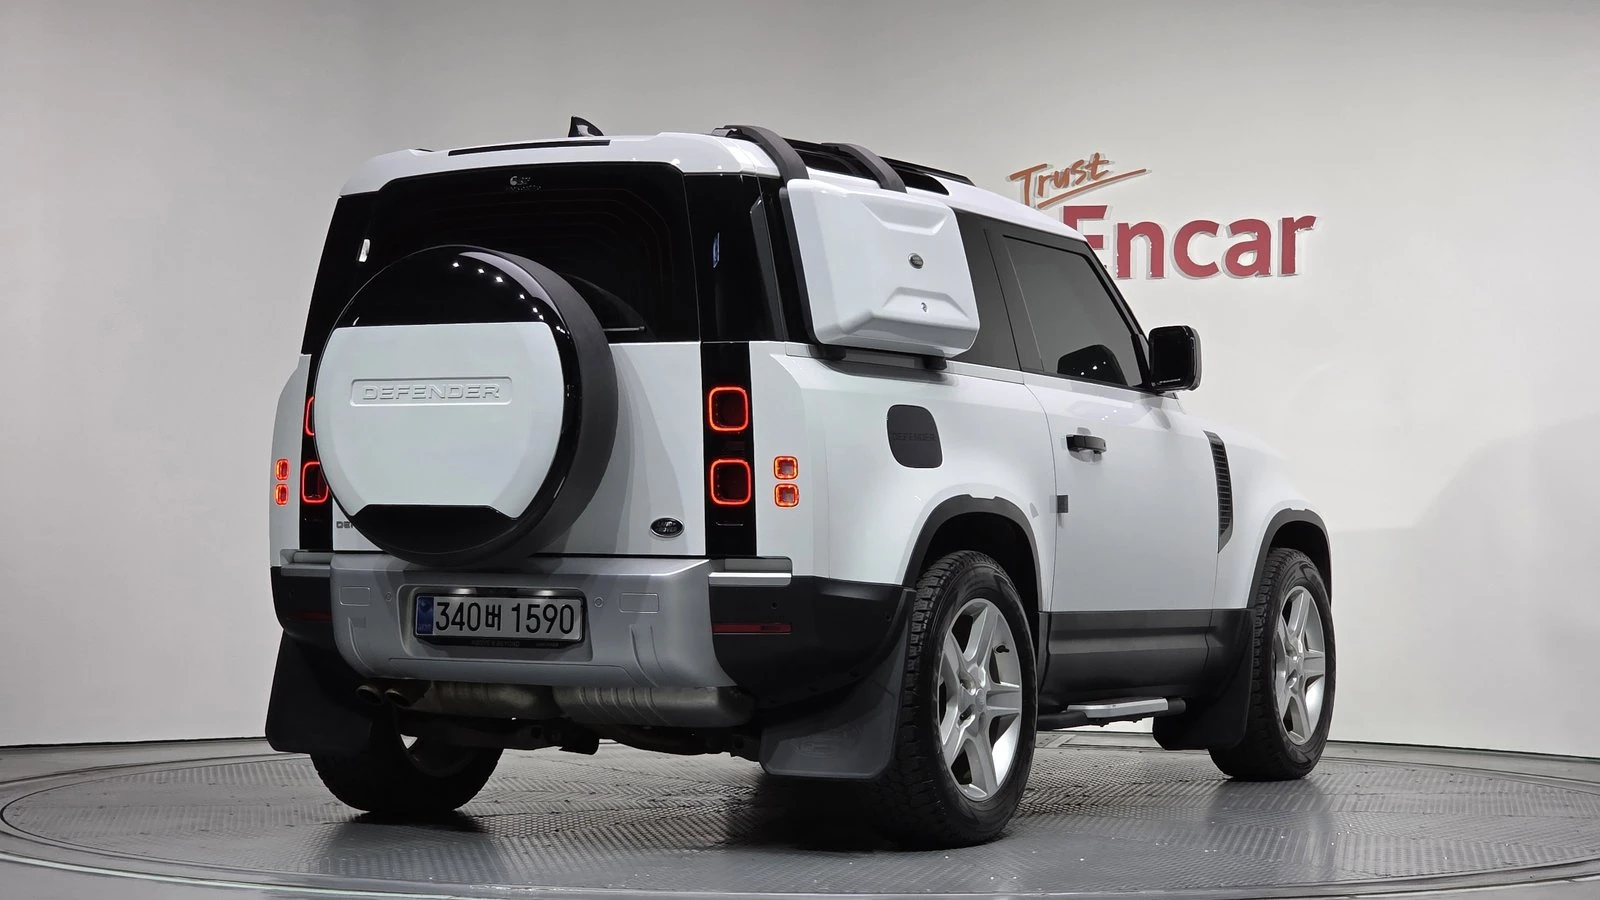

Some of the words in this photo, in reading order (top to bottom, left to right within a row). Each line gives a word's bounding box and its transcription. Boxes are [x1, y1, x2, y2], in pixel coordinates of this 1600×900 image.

[1009, 152, 1110, 206] Trust
[362, 383, 500, 400] DEFENDER
[435, 602, 502, 632] 340버
[511, 603, 575, 634] 1590
